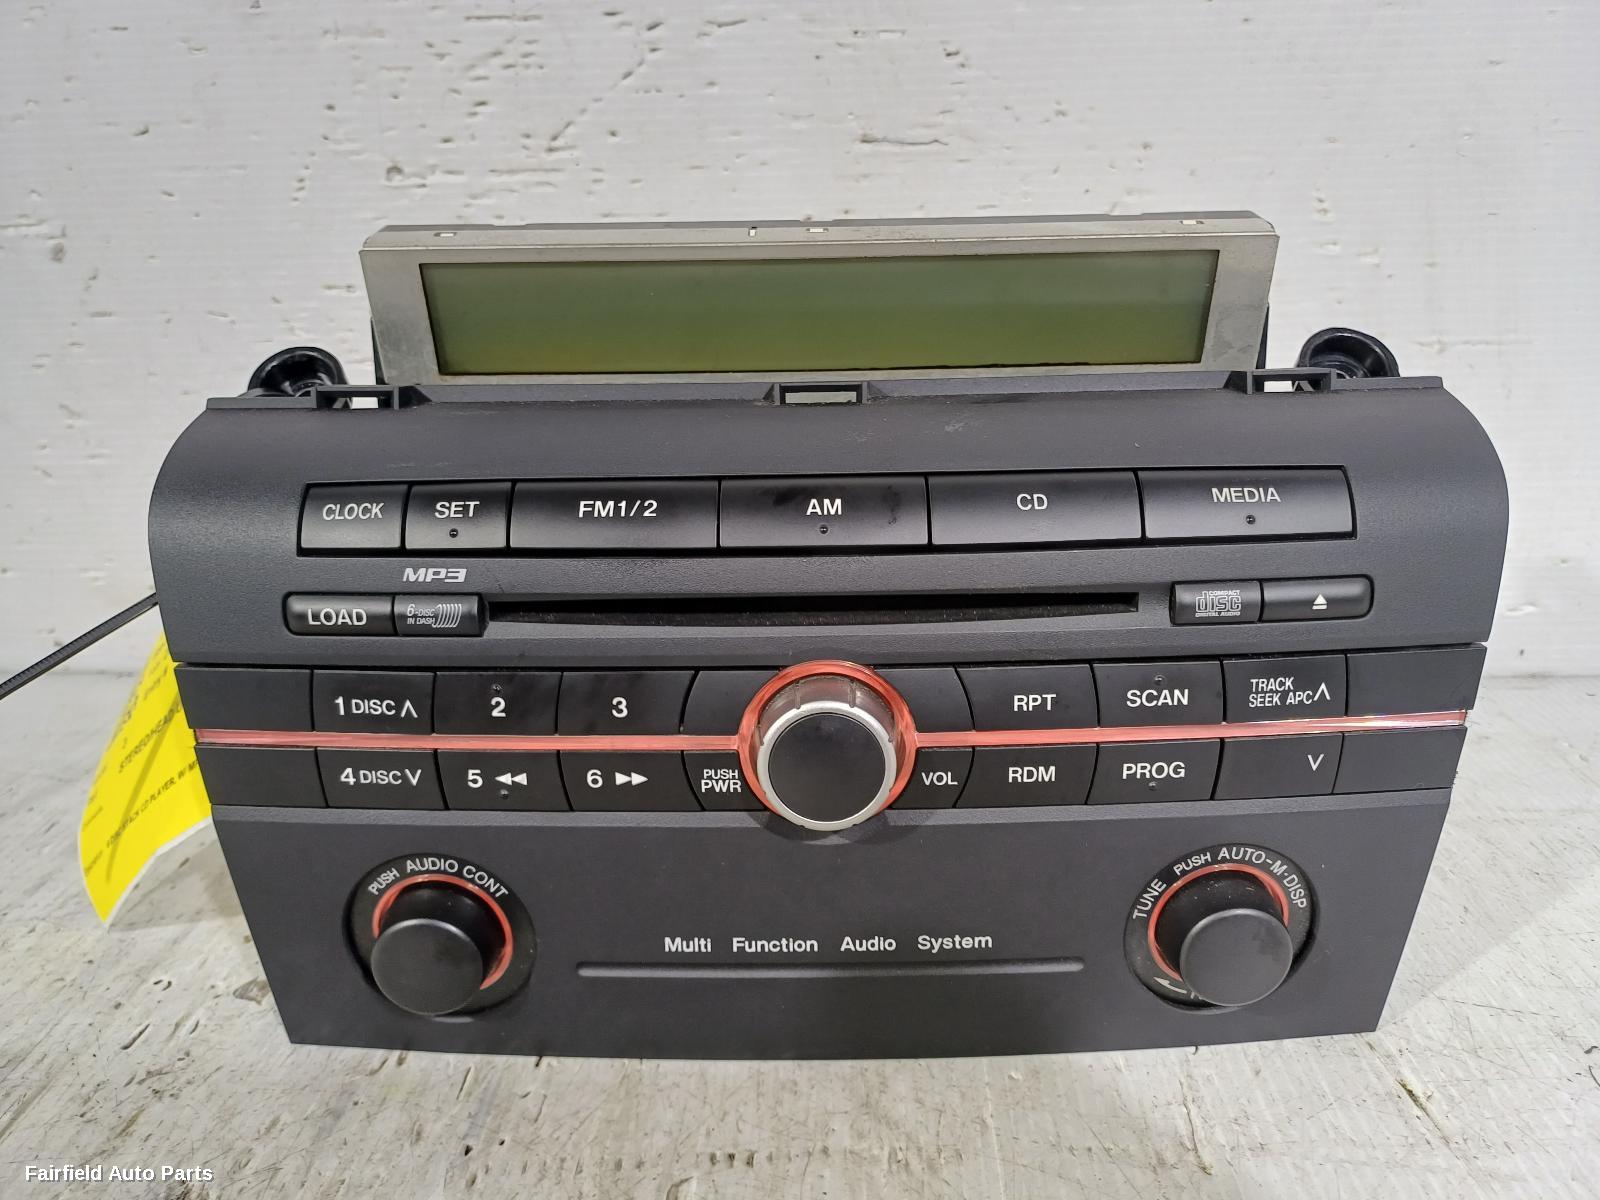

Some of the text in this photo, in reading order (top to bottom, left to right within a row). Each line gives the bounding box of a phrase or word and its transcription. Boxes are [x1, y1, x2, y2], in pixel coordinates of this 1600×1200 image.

[1016, 493, 1048, 511] CD
[1211, 486, 1281, 504] MEDIA
[322, 502, 384, 521] CLOCK
[434, 501, 479, 519] SET
[578, 500, 658, 519] FM1/2
[806, 498, 842, 516] AM
[402, 567, 467, 583] MP3
[307, 607, 367, 626] LOAD
[407, 603, 436, 617] 6-DISC
[407, 617, 436, 625] IN DASH
[1250, 677, 1295, 691] TRACK
[335, 696, 396, 716] 1 DISC
[1013, 693, 1057, 712] RPT
[1126, 688, 1189, 707] SCAN
[1248, 689, 1313, 707] SEEK APC
[491, 697, 506, 718] 2
[611, 697, 628, 717] 3
[340, 768, 403, 786] 4 DISC
[467, 770, 483, 788] 5
[586, 769, 603, 788] 6
[703, 769, 739, 781] PUSH
[921, 771, 958, 786] VOL
[1008, 765, 1056, 784] RDM
[1121, 762, 1186, 780] PROG
[701, 780, 742, 793] PWR
[367, 857, 509, 899] PUSH AUDIO CONT
[1132, 878, 1167, 920] TUNE
[1173, 852, 1212, 876] PUSH
[664, 934, 993, 953] Multi Function Audio System
